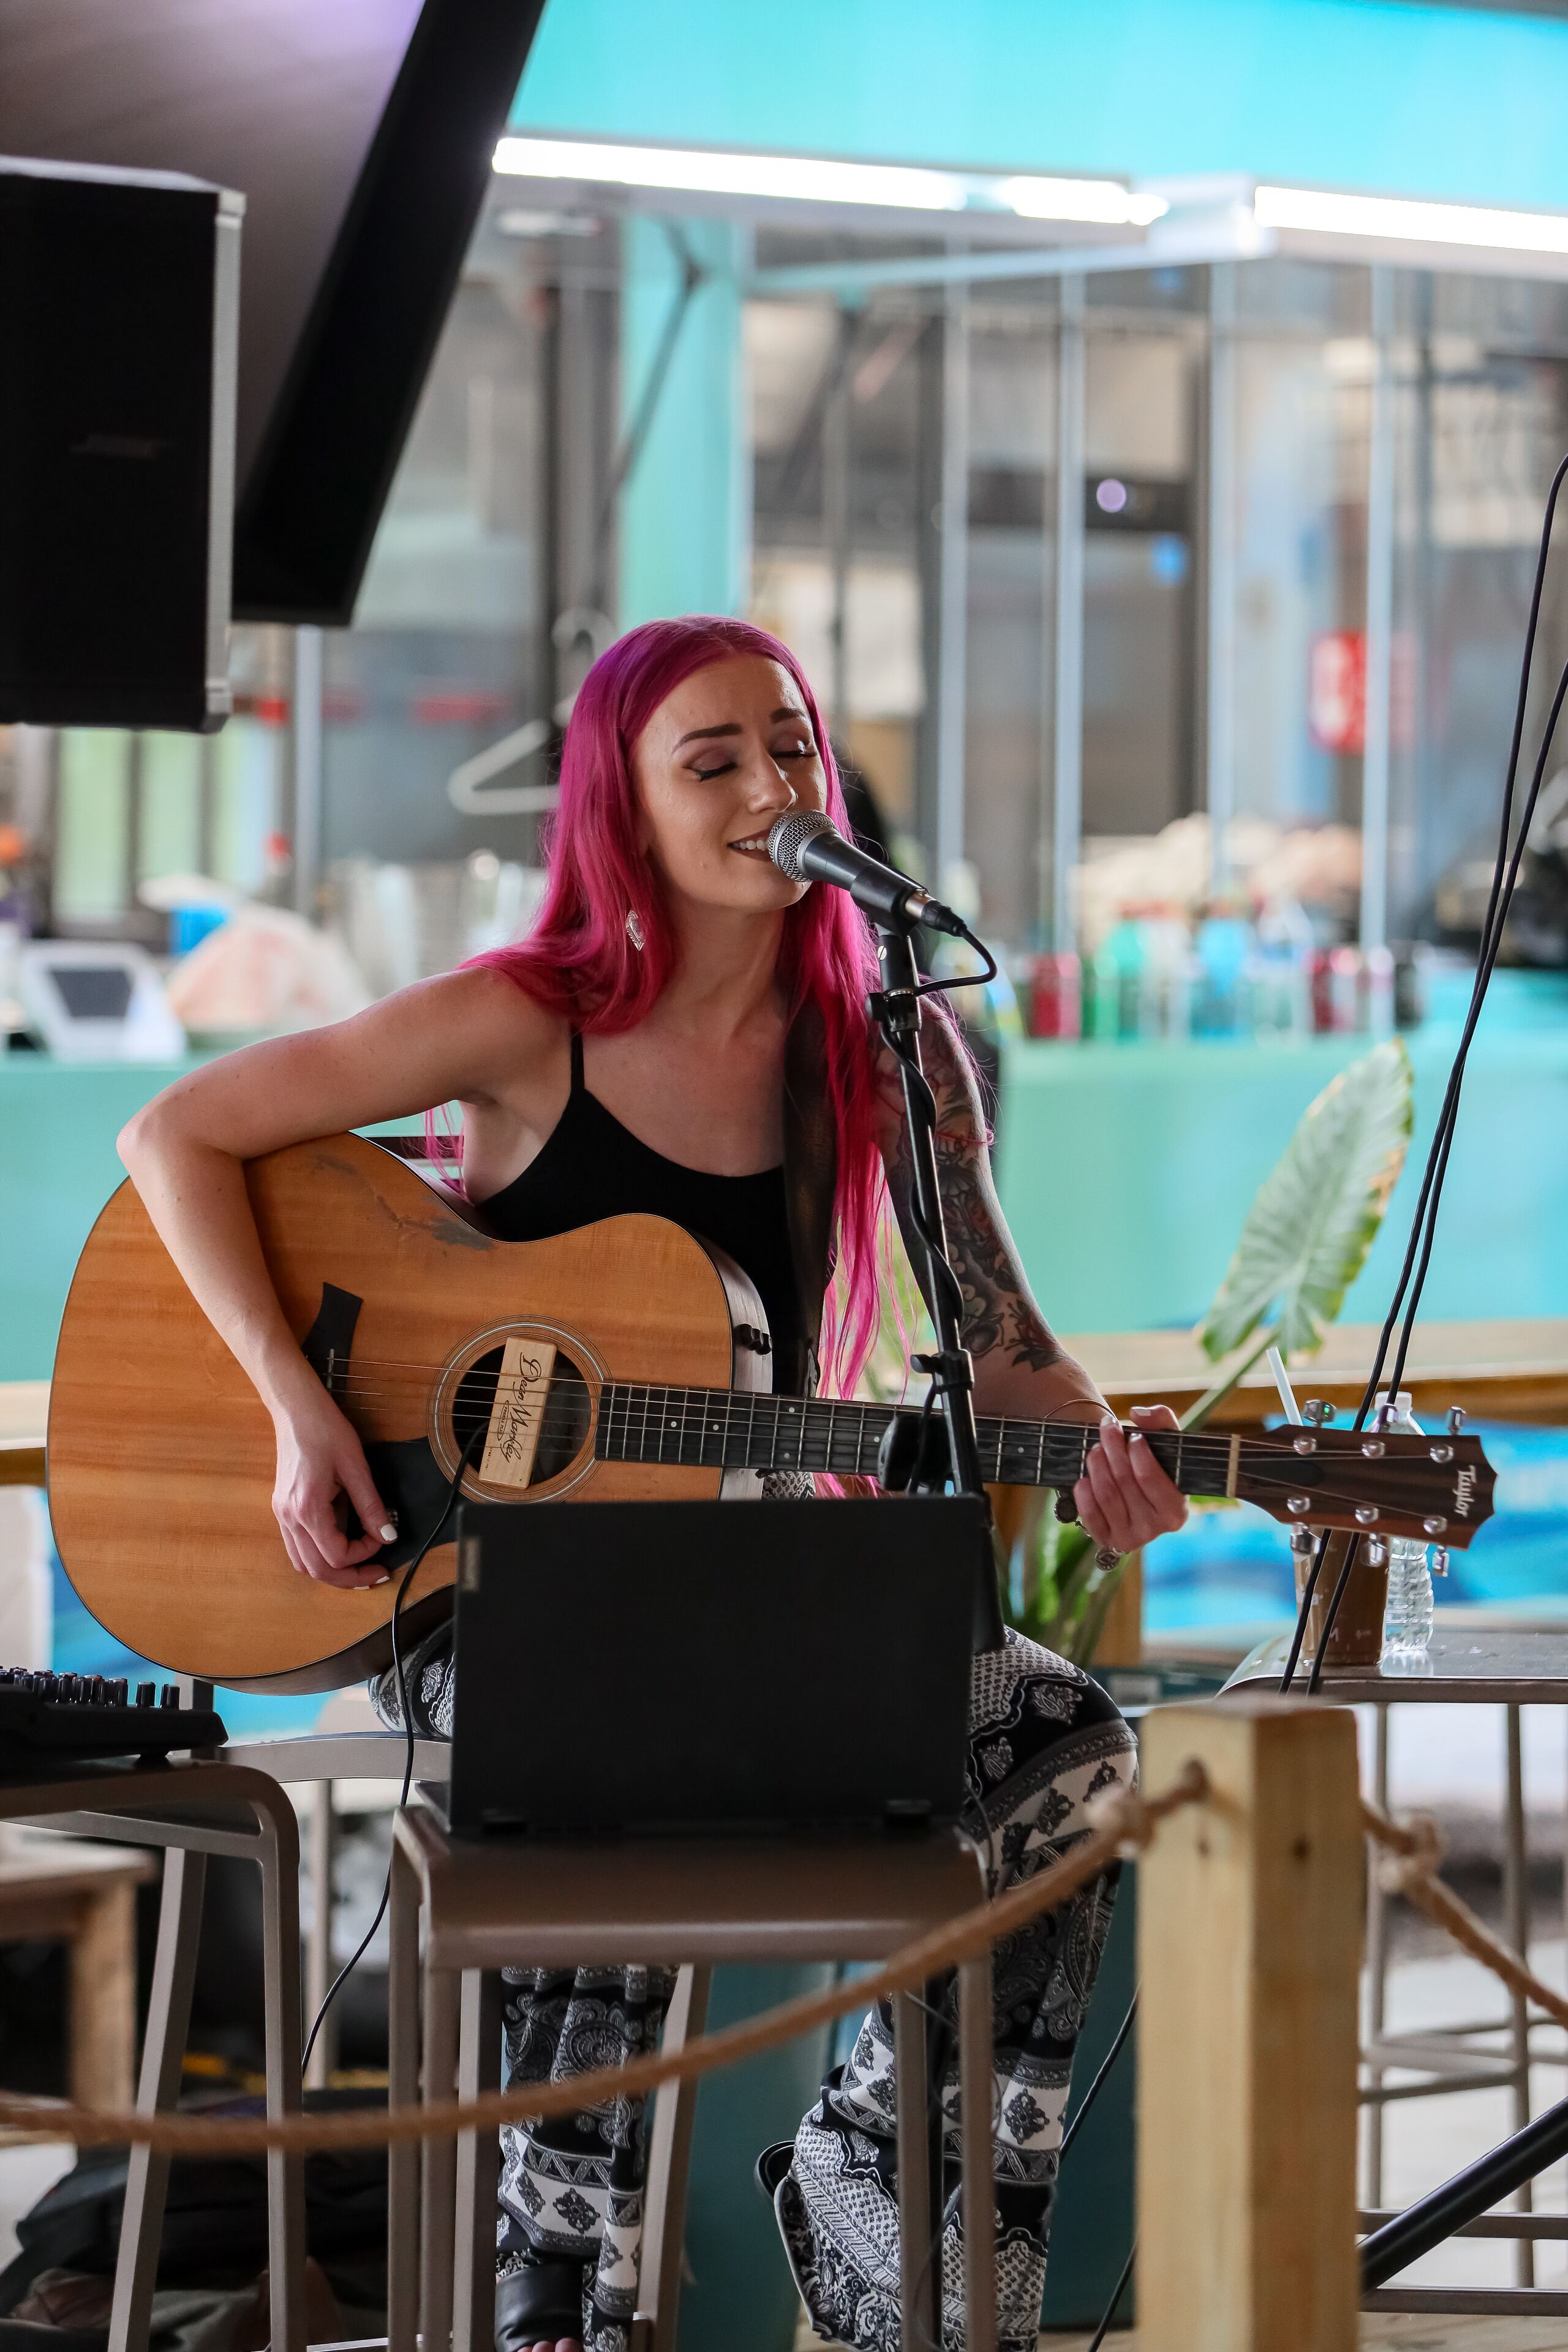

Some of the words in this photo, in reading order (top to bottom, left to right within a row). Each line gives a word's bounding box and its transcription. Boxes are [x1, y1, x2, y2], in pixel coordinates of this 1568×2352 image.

[518, 1352, 542, 1401] Dean
[500, 1381, 532, 1463] Markley
[1452, 1465, 1476, 1518] Taylor
